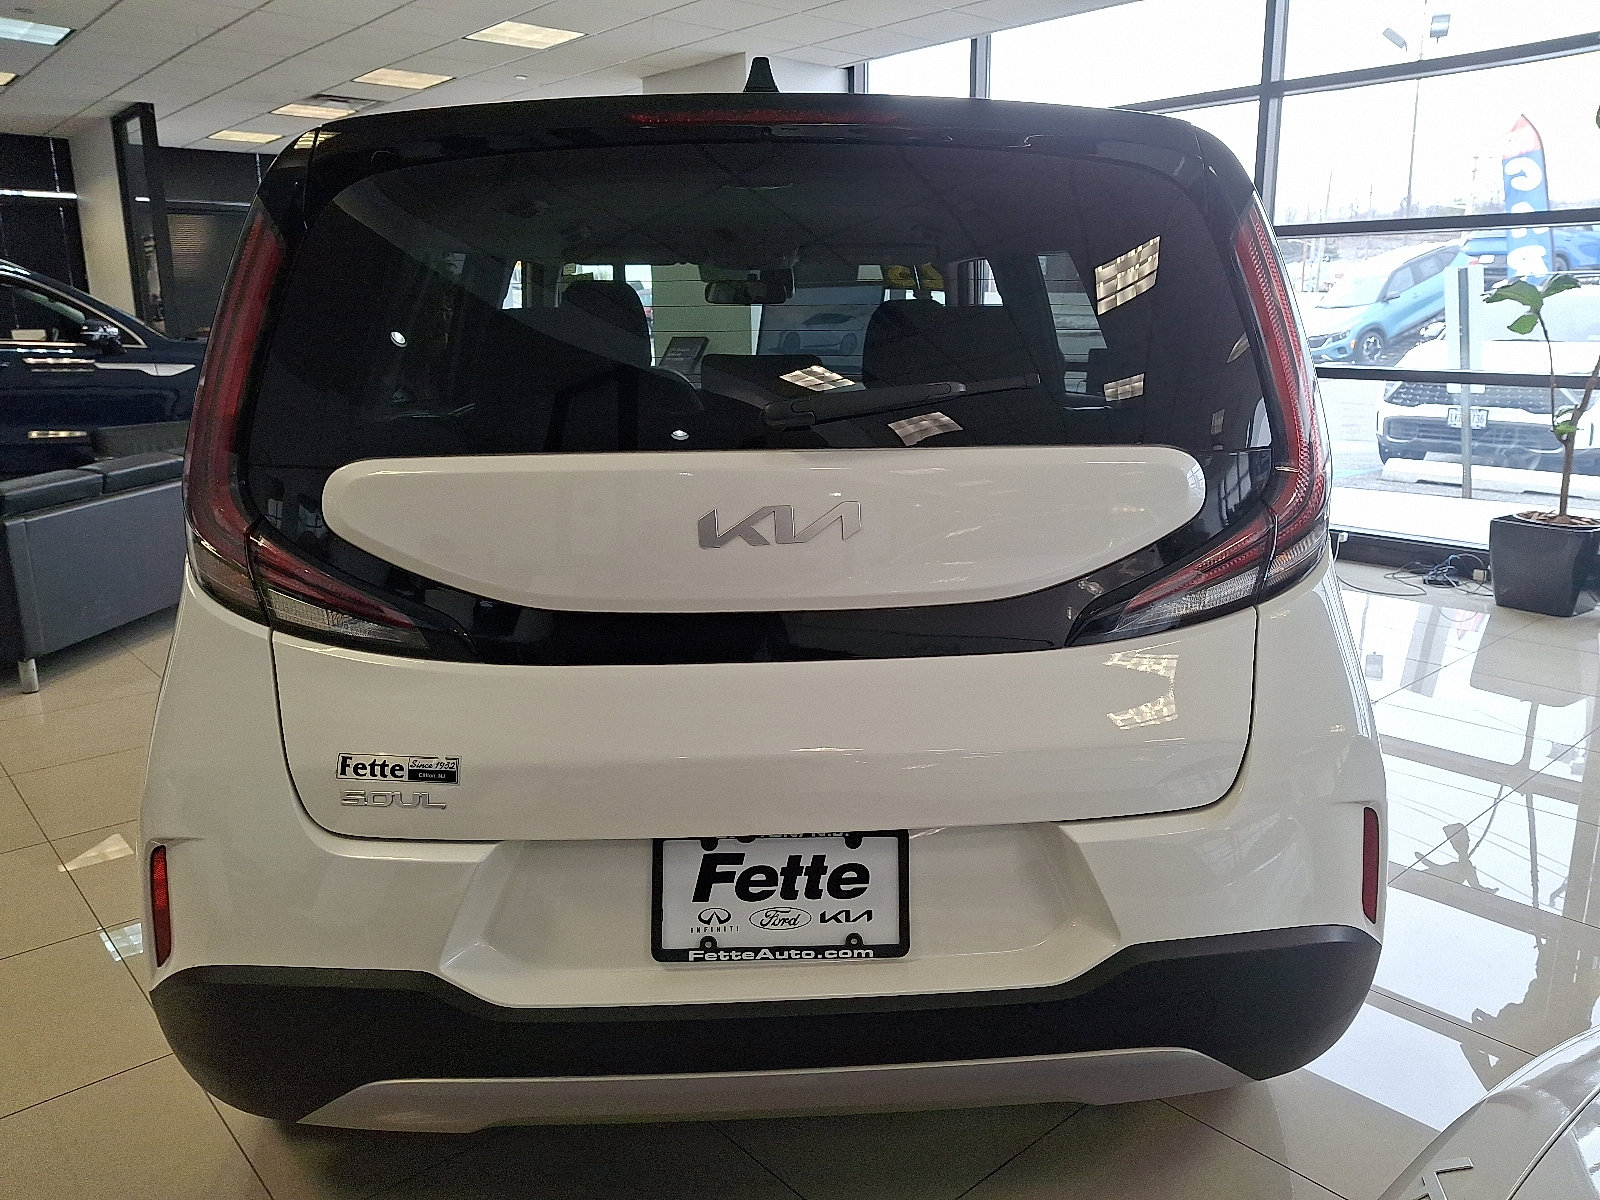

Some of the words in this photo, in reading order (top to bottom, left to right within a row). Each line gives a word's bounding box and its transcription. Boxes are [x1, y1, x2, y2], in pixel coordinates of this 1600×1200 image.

[698, 500, 862, 549] KIA
[339, 756, 405, 778] Fette
[409, 760, 434, 769] Since
[341, 790, 447, 810] SOUL
[691, 852, 871, 903] Fette
[758, 909, 802, 928] Ford
[819, 909, 874, 924] KIA
[690, 925, 739, 934] INFINITI
[688, 948, 874, 962] FetteAuto.com
